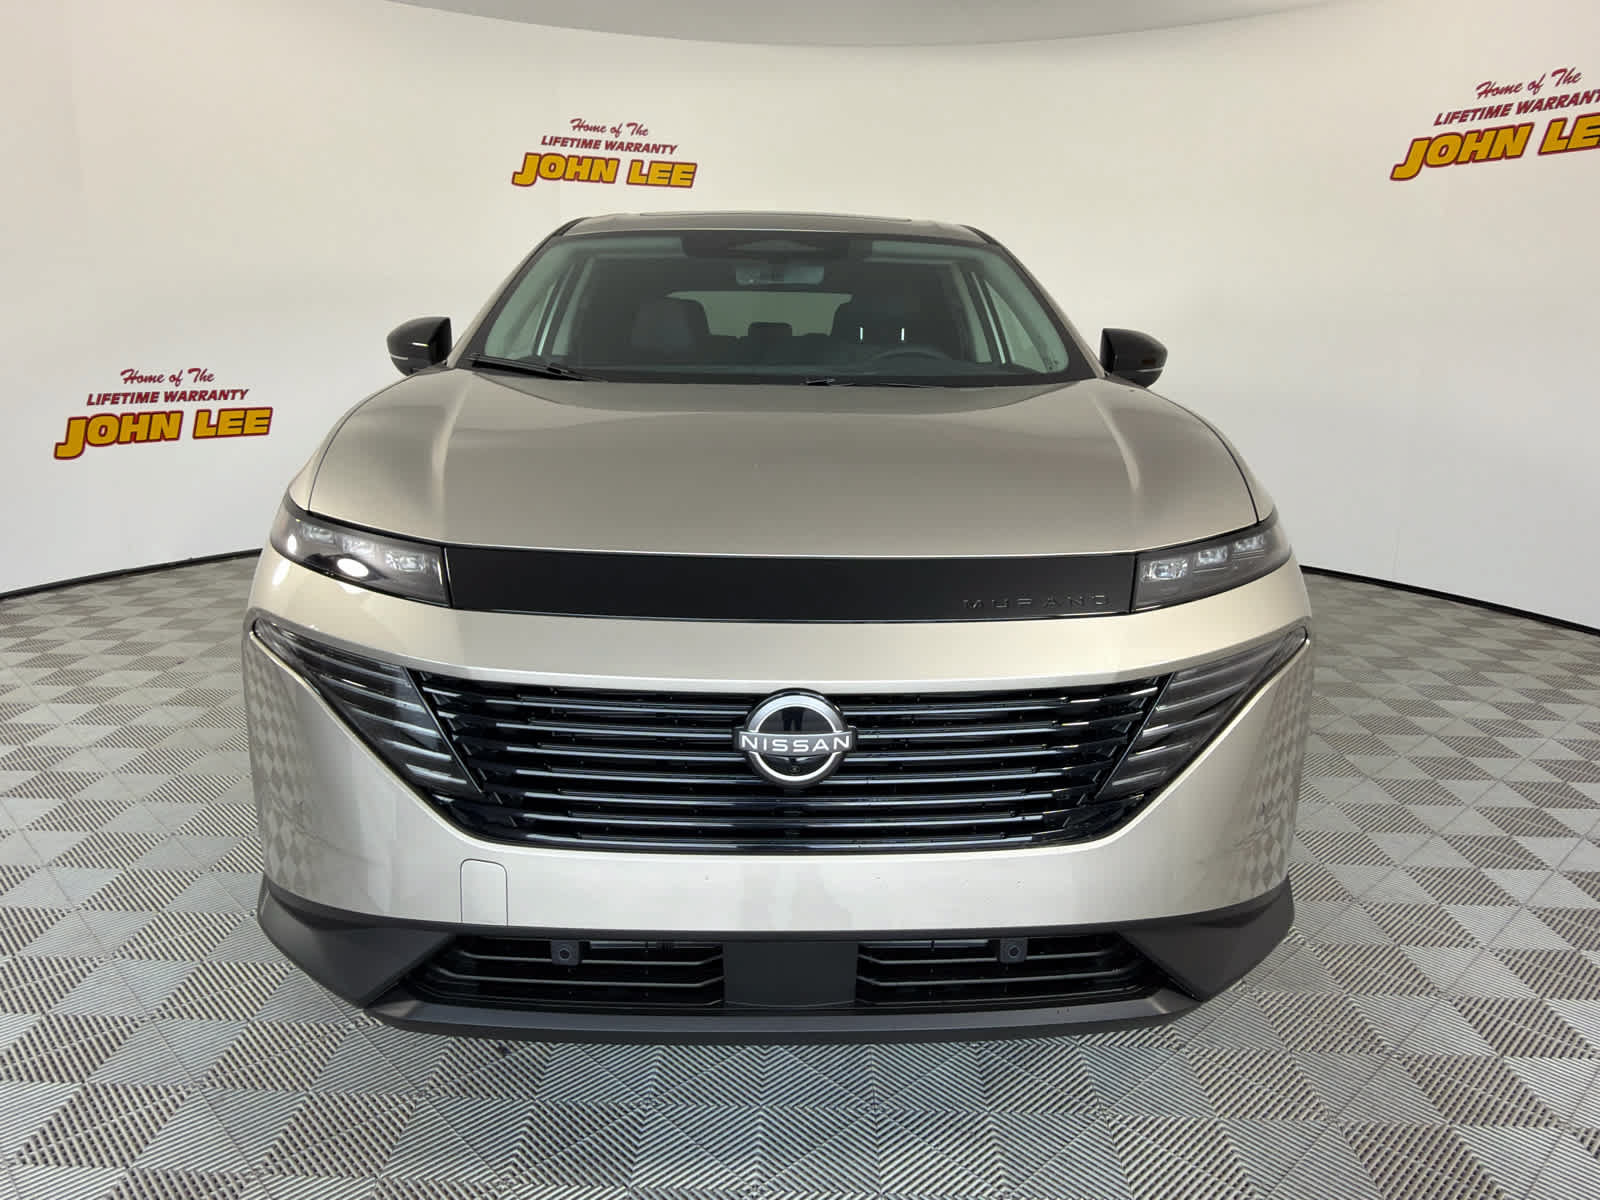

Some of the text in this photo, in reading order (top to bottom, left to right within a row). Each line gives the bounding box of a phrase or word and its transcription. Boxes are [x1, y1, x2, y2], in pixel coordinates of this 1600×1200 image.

[1475, 67, 1582, 99] Home of The
[1433, 103, 1514, 126] LIFETIME
[570, 117, 649, 138] Home of The
[541, 135, 677, 155] LIFETIME WARRANTY
[1390, 122, 1535, 181] JOHN
[511, 152, 697, 188] JOHN LEE
[120, 367, 215, 387] Home of The
[86, 388, 249, 406] LIFETIME WARRANTY
[54, 407, 273, 460] JOHN LEE
[741, 735, 850, 752] NISSAN
